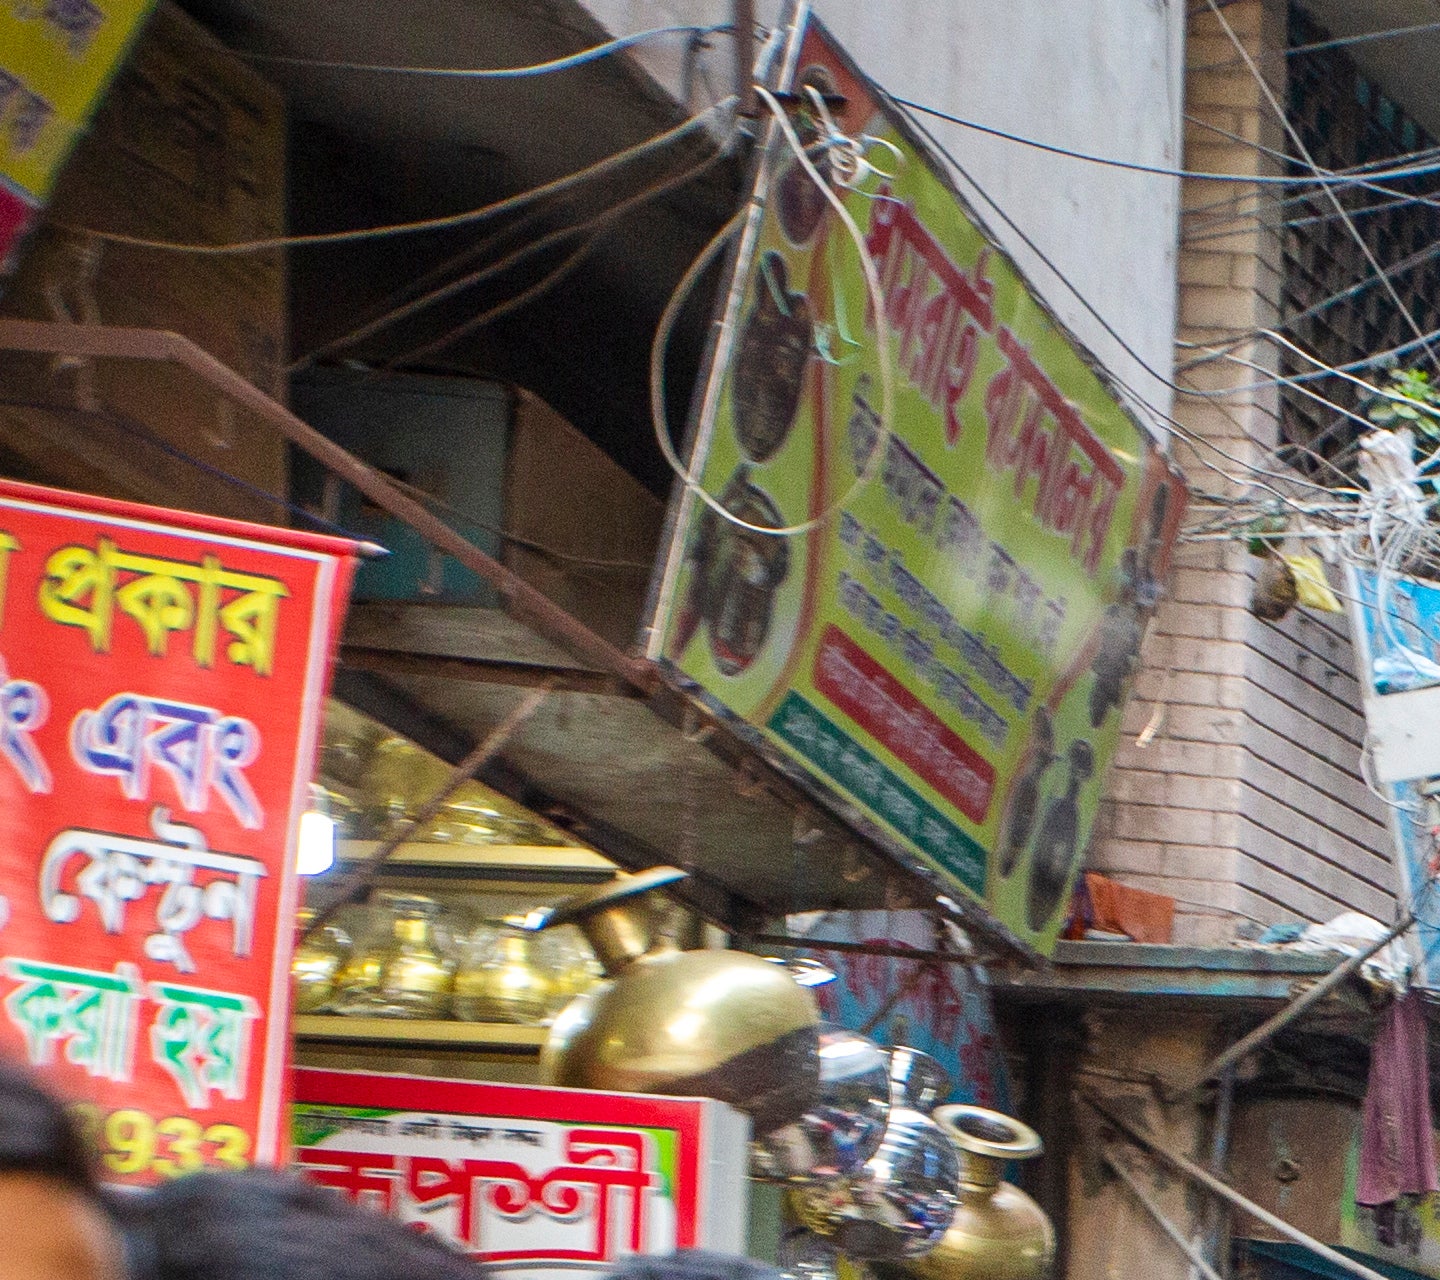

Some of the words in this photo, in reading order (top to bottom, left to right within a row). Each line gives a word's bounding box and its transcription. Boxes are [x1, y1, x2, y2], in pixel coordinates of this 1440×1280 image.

[40, 533, 291, 678] প্রকার
[68, 691, 265, 830] এবং
[1, 955, 150, 1083] করা
[150, 981, 262, 1110] হয়
